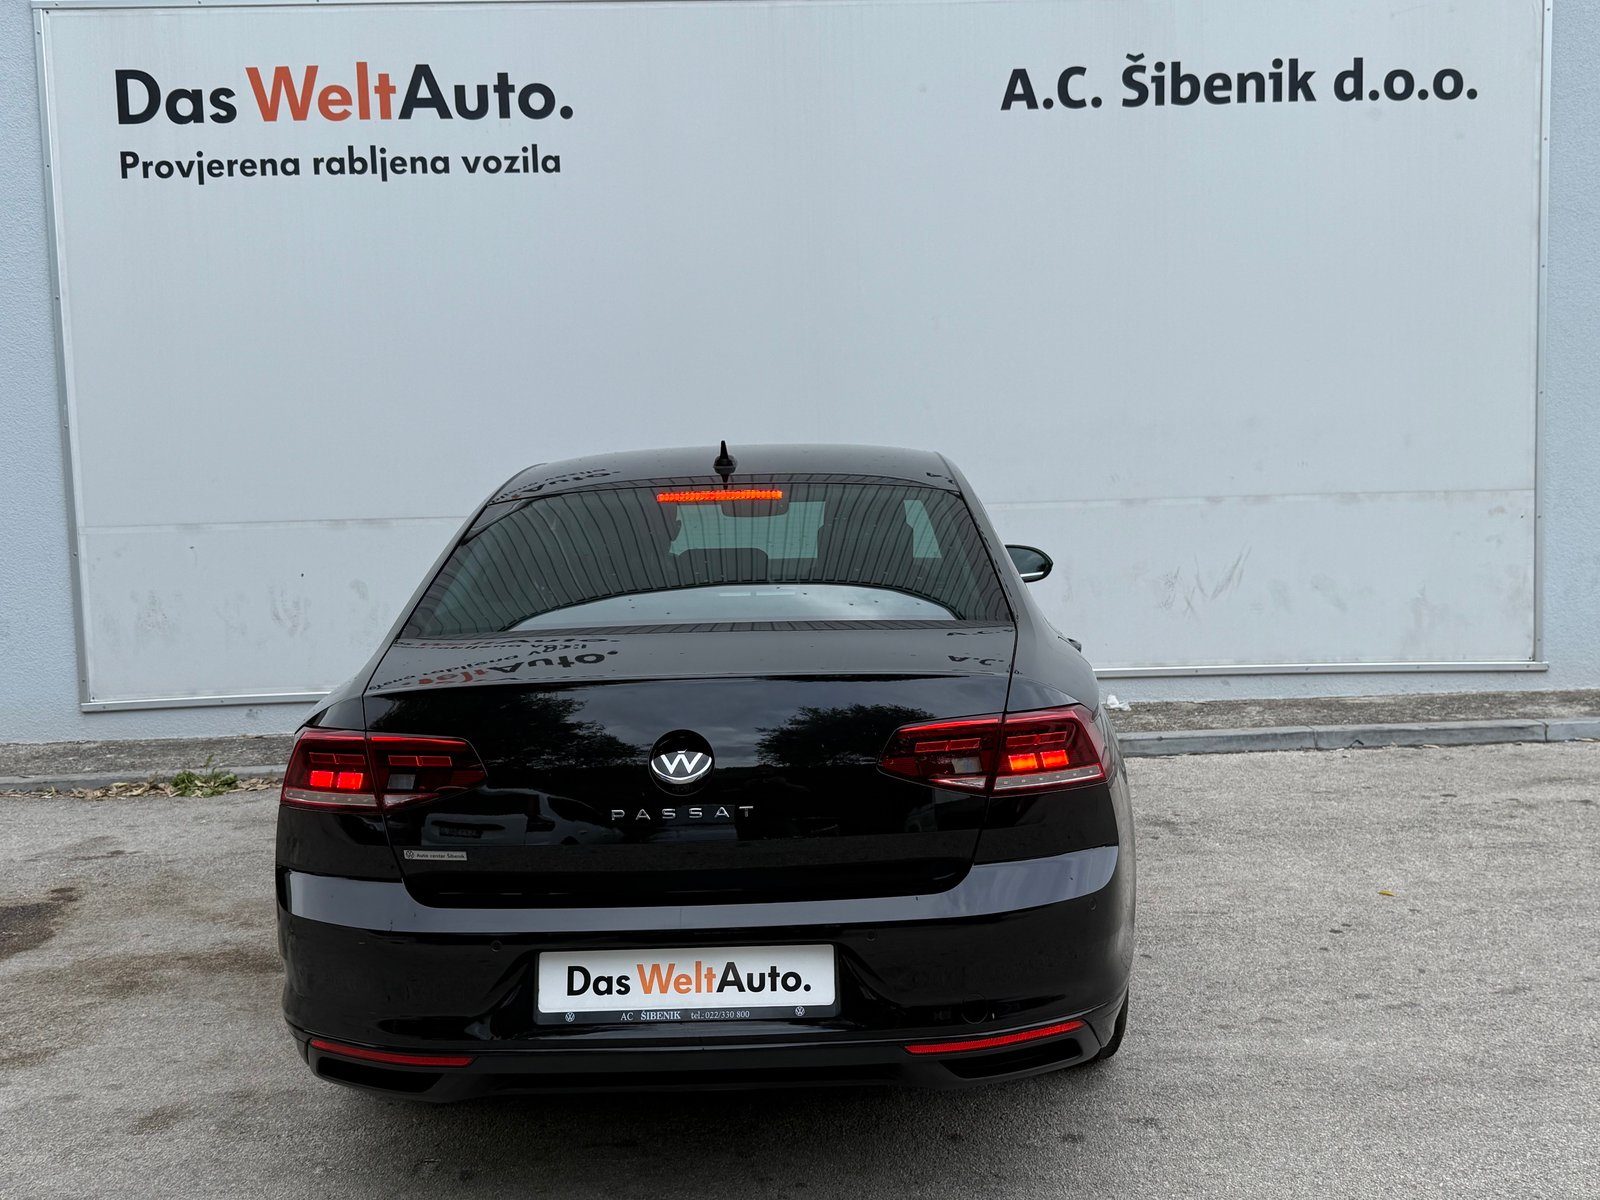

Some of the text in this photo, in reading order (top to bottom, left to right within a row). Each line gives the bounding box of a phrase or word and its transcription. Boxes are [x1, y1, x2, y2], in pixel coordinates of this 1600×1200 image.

[115, 62, 573, 124] Das WeltAuto.
[1001, 53, 1479, 110] A.C. Šibenik d.o.o.
[120, 144, 561, 185] Provjerena rabljena vozila
[611, 805, 754, 821] PASSAT
[567, 961, 812, 996] Das WeltAuto.
[620, 1012, 634, 1021] AC
[736, 1010, 750, 1018] 800
